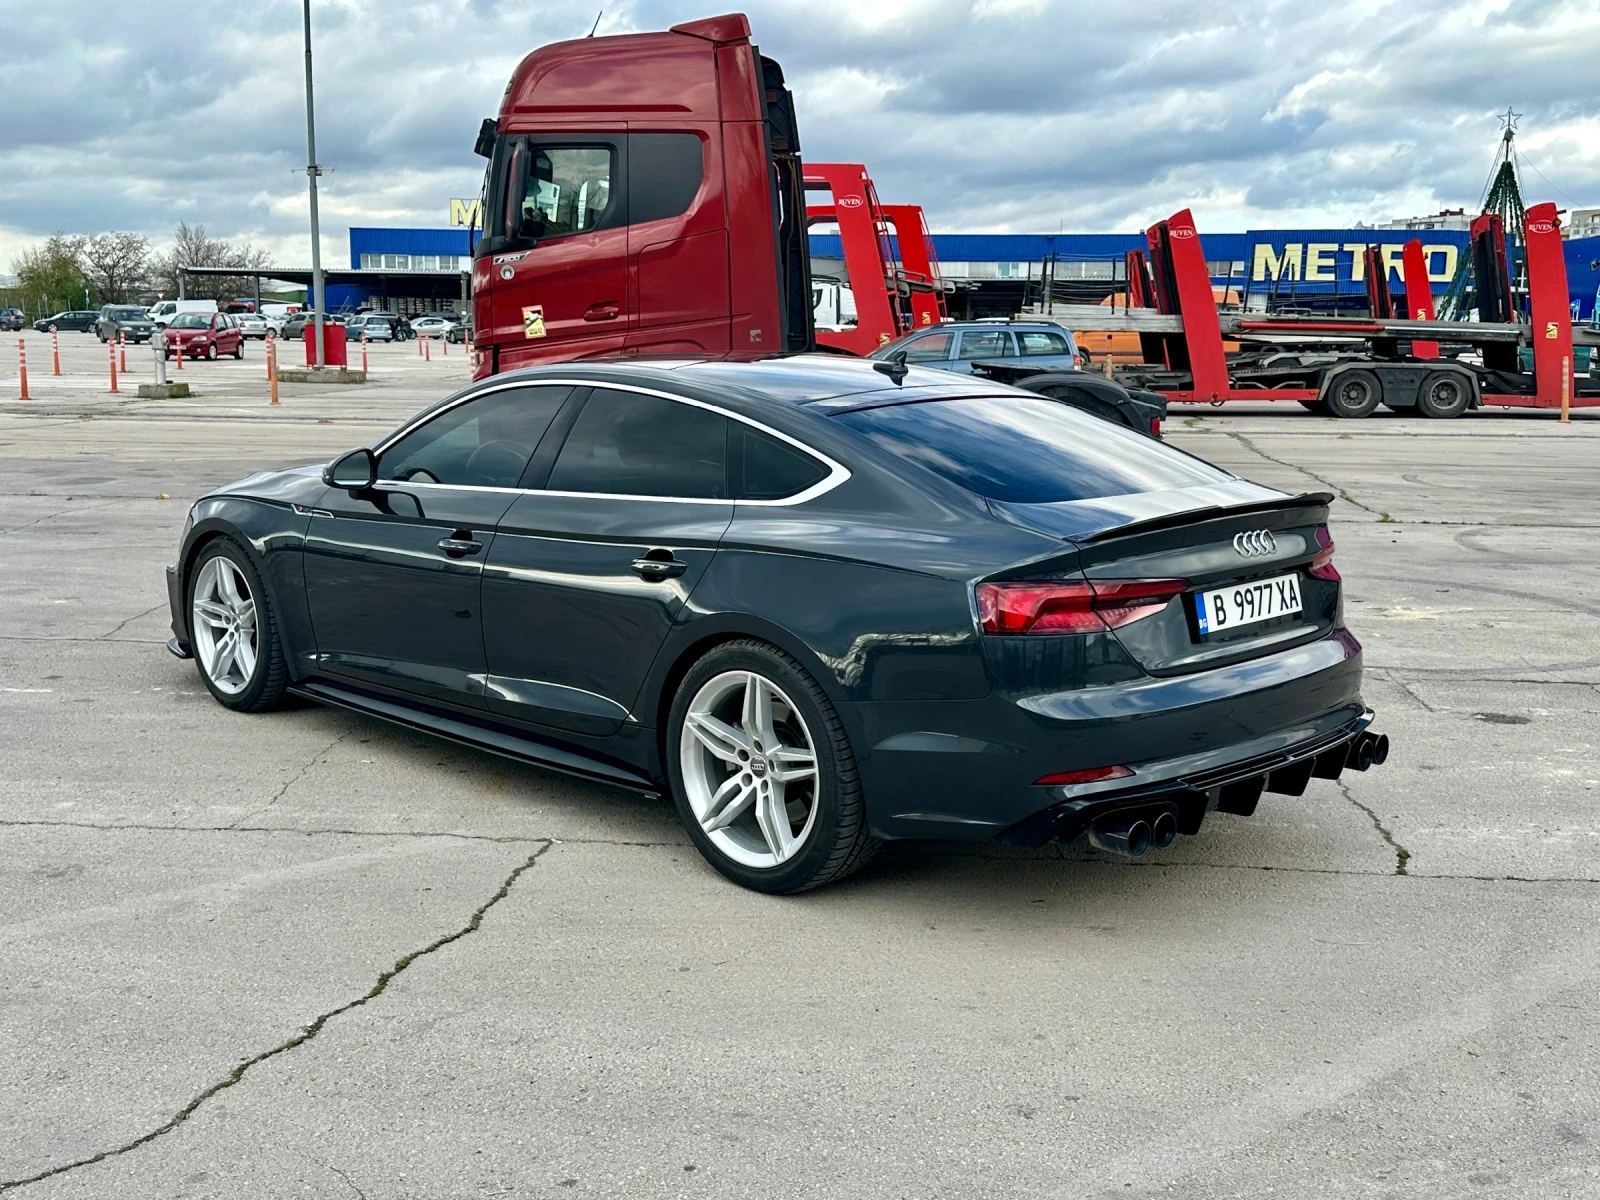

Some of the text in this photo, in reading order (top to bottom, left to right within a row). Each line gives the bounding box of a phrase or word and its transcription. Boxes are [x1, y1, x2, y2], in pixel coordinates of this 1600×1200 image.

[838, 197, 861, 206] RUVEN
[1528, 223, 1553, 231] RUVEN
[1169, 228, 1192, 237] RUVEN
[1253, 243, 1458, 282] METRO
[1213, 579, 1299, 626] B 9977 XA
[1199, 618, 1207, 628] BG
